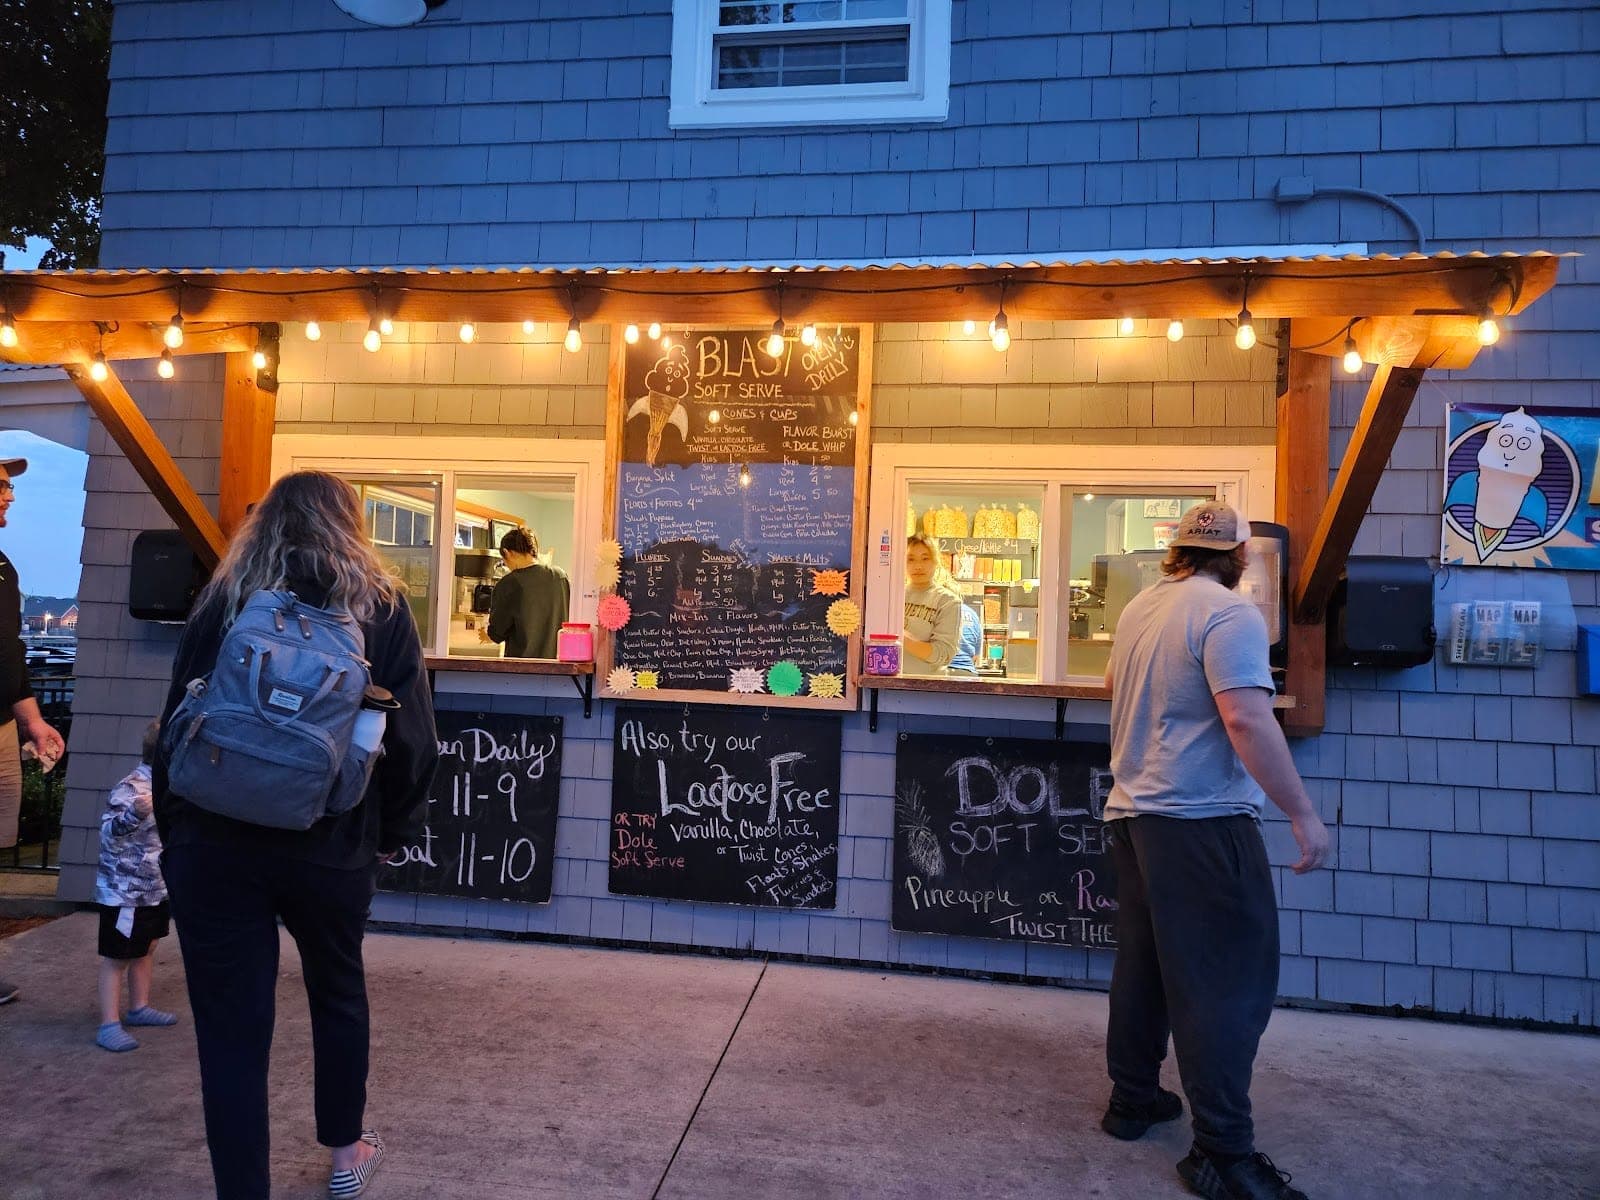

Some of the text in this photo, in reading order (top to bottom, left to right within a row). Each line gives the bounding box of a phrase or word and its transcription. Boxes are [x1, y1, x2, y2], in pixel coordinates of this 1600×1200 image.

[695, 335, 801, 379] BLAST
[804, 352, 848, 391] DAILY
[694, 383, 784, 399] SOFT SERVE
[722, 408, 756, 419] CONES
[770, 409, 799, 420] CUPS
[783, 425, 855, 440] FLAVOR BURST
[792, 441, 819, 451] DOLE
[822, 441, 846, 452] WHIP
[653, 468, 676, 484] Split
[812, 488, 821, 500] 5
[1187, 528, 1222, 537] ARIAT
[713, 588, 721, 600] 5
[726, 610, 759, 620] Flavors
[1476, 608, 1501, 622] MAP
[1513, 609, 1538, 624] MAP
[621, 719, 762, 763] Also, try our
[460, 728, 556, 779] Daily
[453, 771, 519, 823] 11-9
[658, 751, 833, 824] Lactose Free
[944, 756, 1114, 822] DOLE
[614, 812, 658, 829] OR TRY
[670, 816, 820, 843] Vanilla, Chocolate,
[614, 828, 659, 851] Dole
[949, 820, 1114, 856] SOFT SER
[457, 832, 536, 887] 11-10
[612, 850, 686, 869] Soft Serve
[729, 844, 769, 863] Twist
[904, 875, 1021, 914] Pineapple
[989, 911, 1069, 941] TWIST
